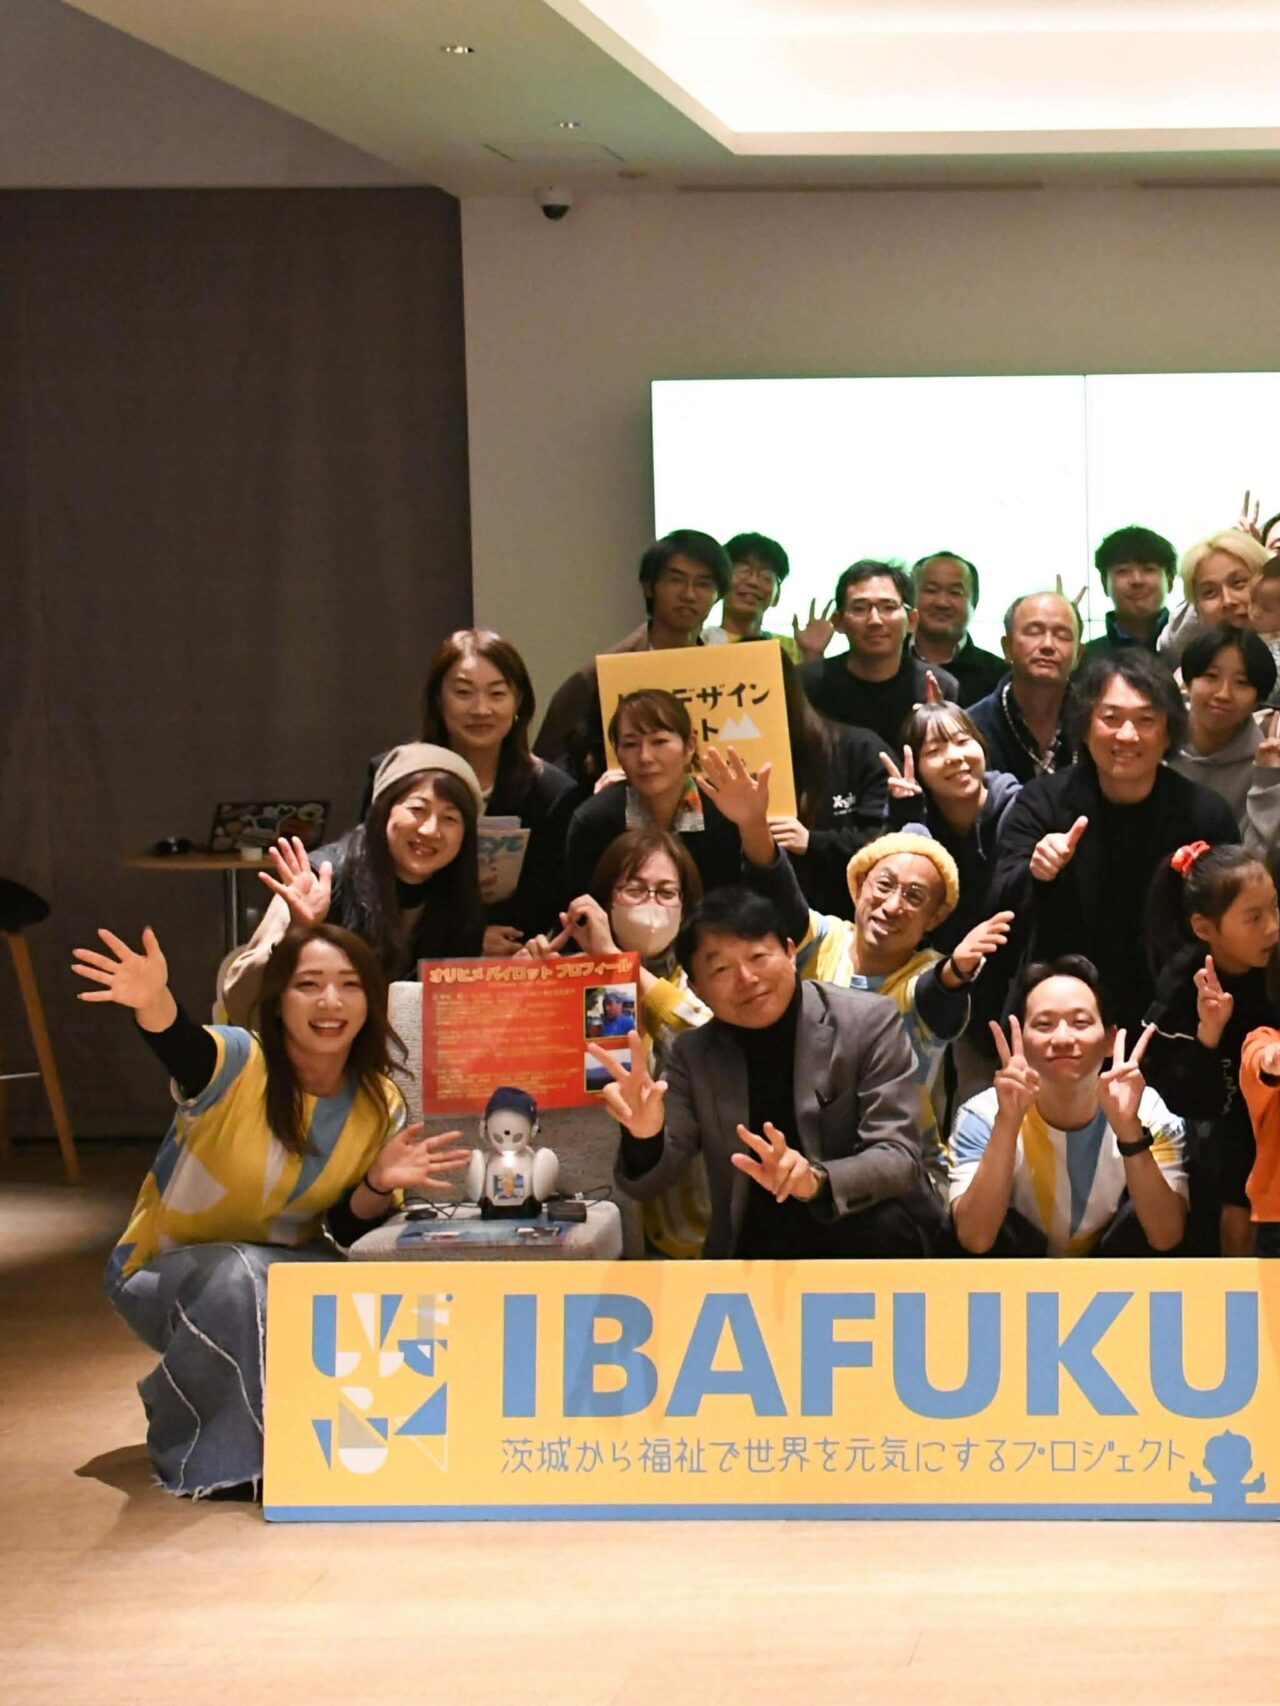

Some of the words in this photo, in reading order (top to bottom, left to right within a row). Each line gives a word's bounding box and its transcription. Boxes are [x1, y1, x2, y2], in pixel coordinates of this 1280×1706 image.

[617, 682, 770, 711] デザイン
[502, 1291, 1259, 1420] IBAFUKU
[501, 1436, 1186, 1473] 茨城から福祉で世界を元気にするプロジェクト
